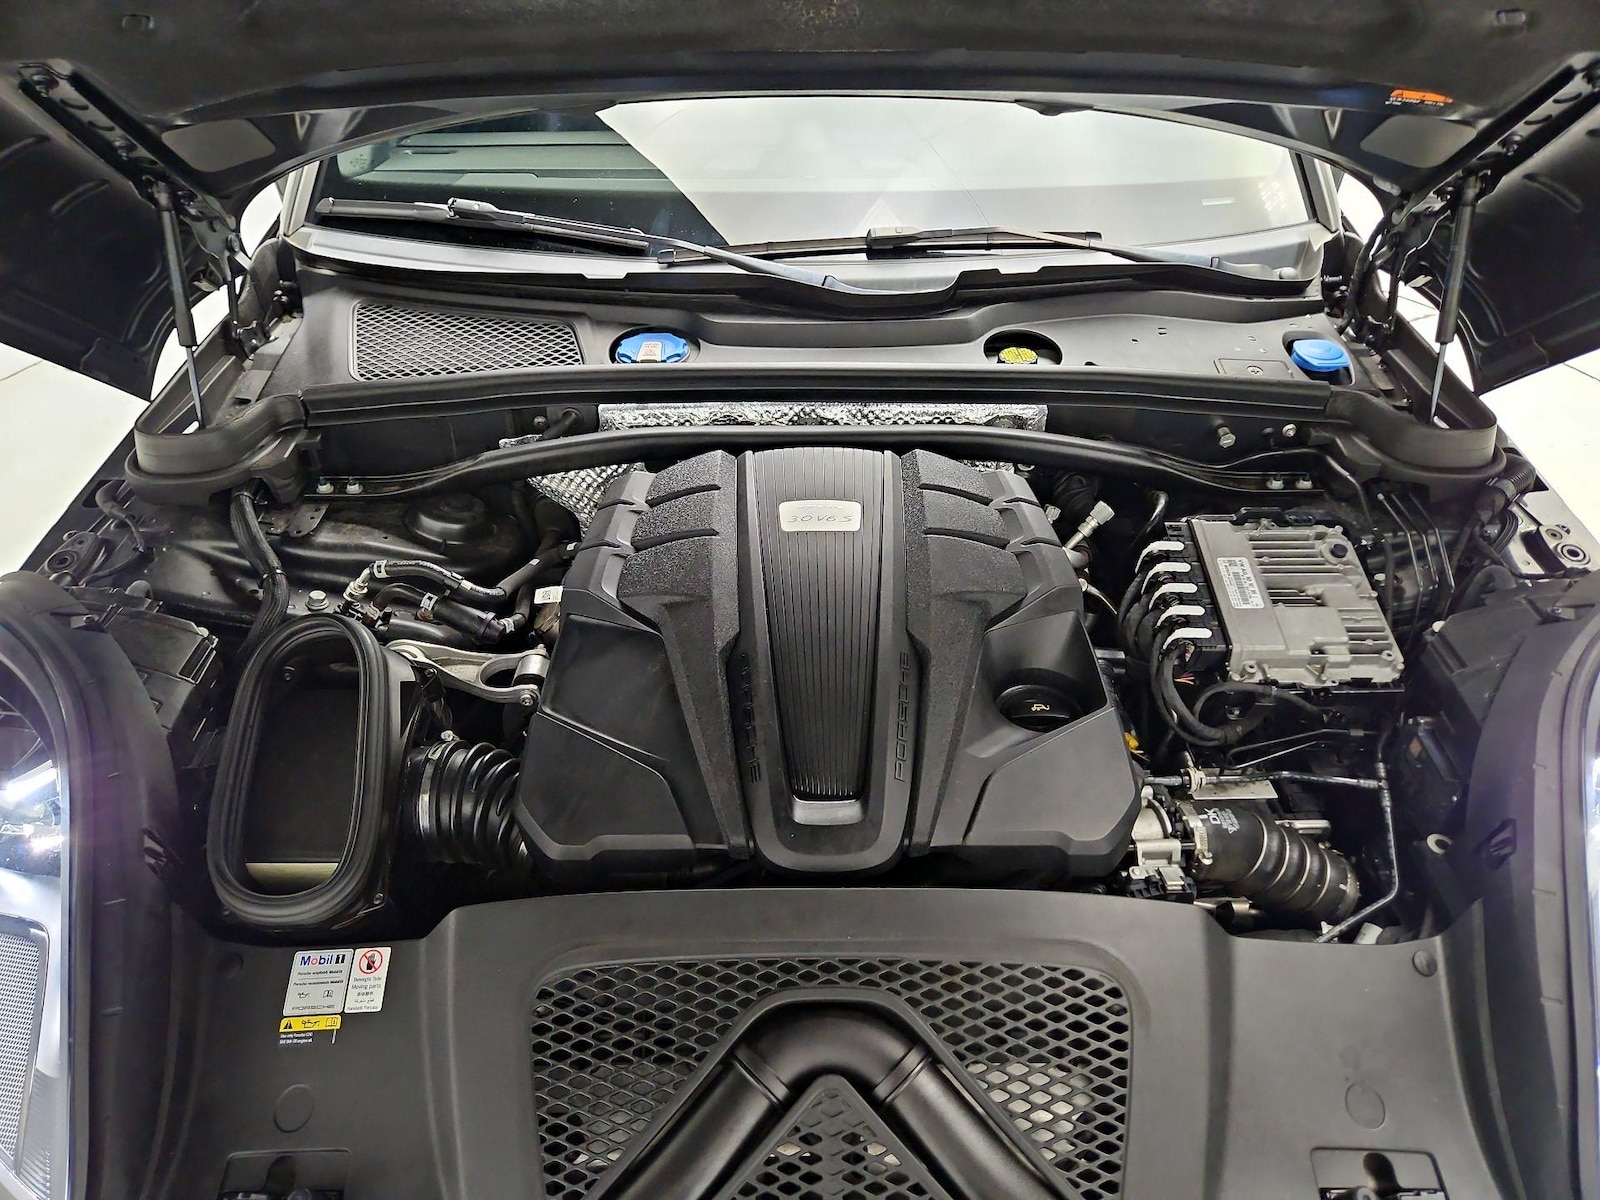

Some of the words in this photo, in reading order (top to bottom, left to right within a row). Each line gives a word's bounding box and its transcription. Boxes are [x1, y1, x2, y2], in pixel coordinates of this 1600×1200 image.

[817, 514, 836, 522] V6
[894, 651, 910, 783] PORSCHE
[300, 954, 334, 966] Mobil
